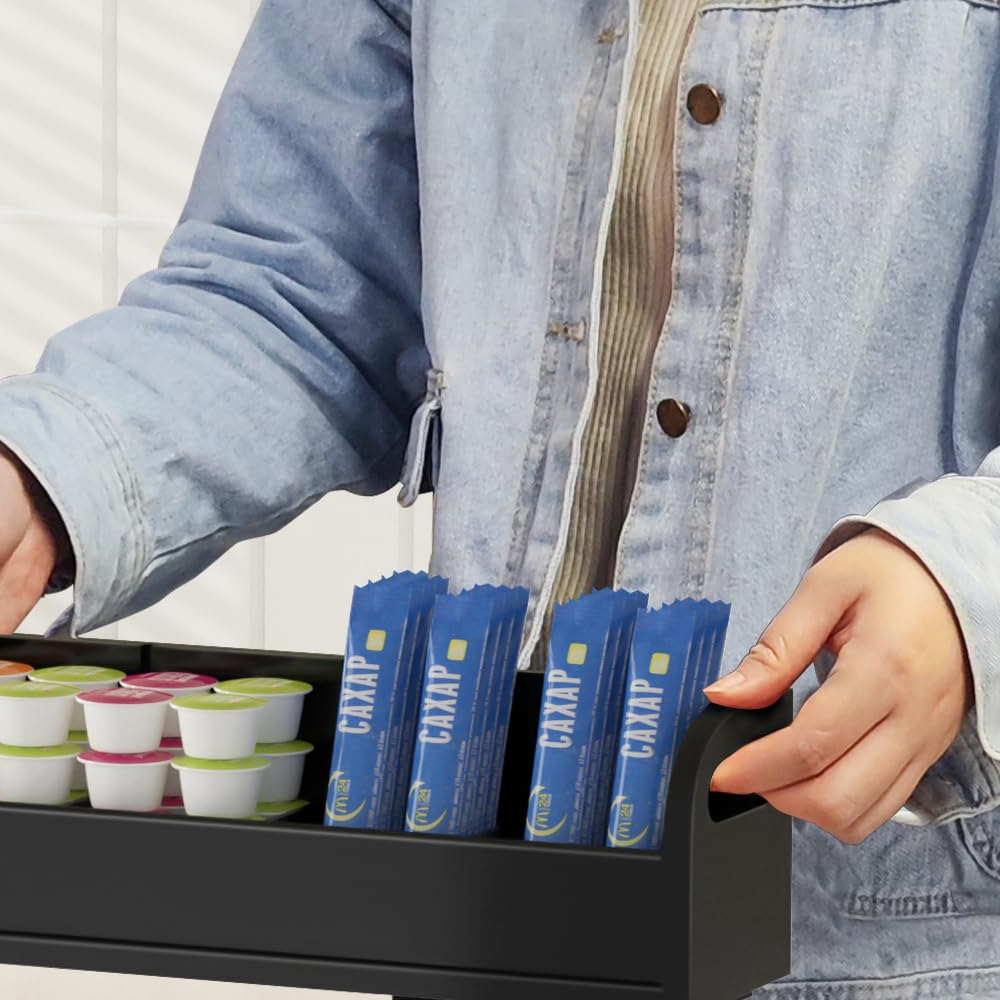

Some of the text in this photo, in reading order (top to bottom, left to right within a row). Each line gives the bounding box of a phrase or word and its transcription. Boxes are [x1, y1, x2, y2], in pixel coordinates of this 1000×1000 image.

[338, 656, 380, 734] САХАР
[419, 664, 461, 744] САХАР
[539, 669, 581, 748] САХАР
[621, 679, 664, 758] САХАР
